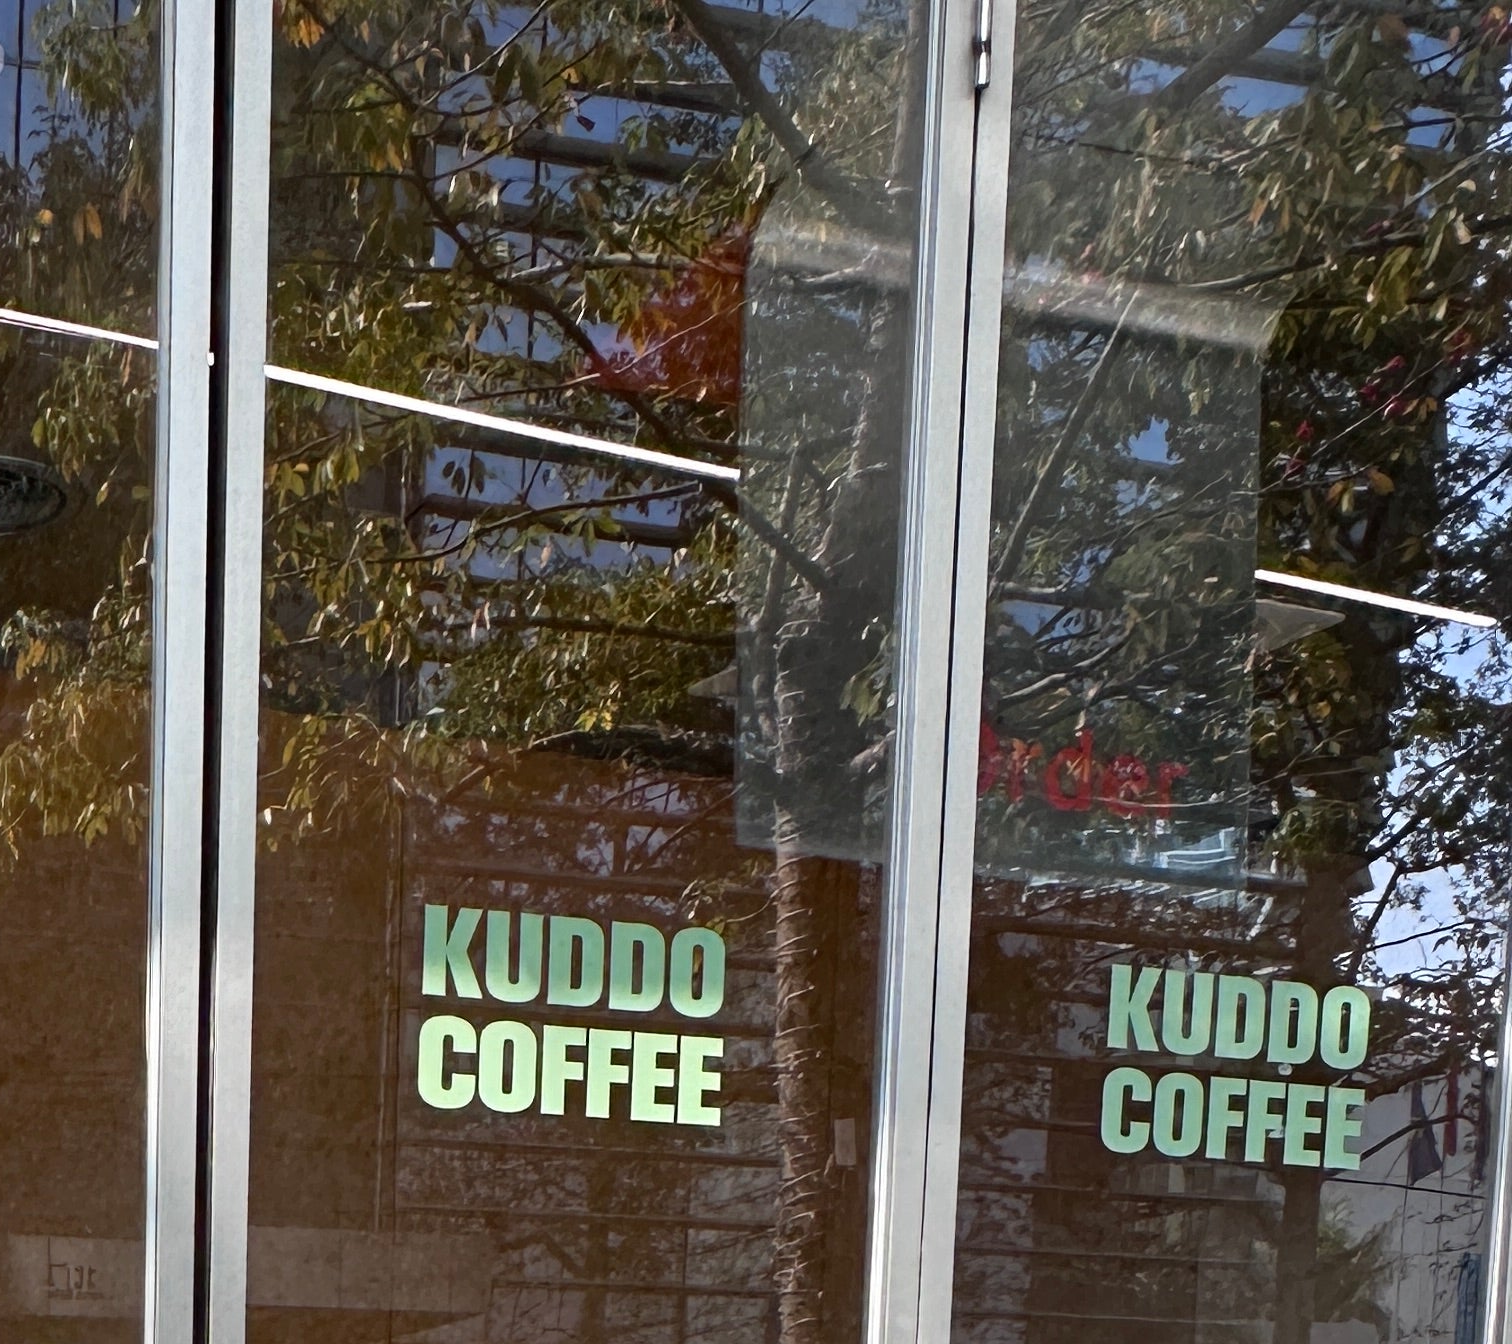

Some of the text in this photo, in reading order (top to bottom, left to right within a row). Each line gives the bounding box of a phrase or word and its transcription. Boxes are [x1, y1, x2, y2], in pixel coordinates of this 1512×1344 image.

[422, 904, 726, 1018] KUDDO
[417, 1015, 724, 1126] COFFEE
[1107, 964, 1371, 1070] KUDDO
[1101, 1066, 1366, 1170] COFFEE
